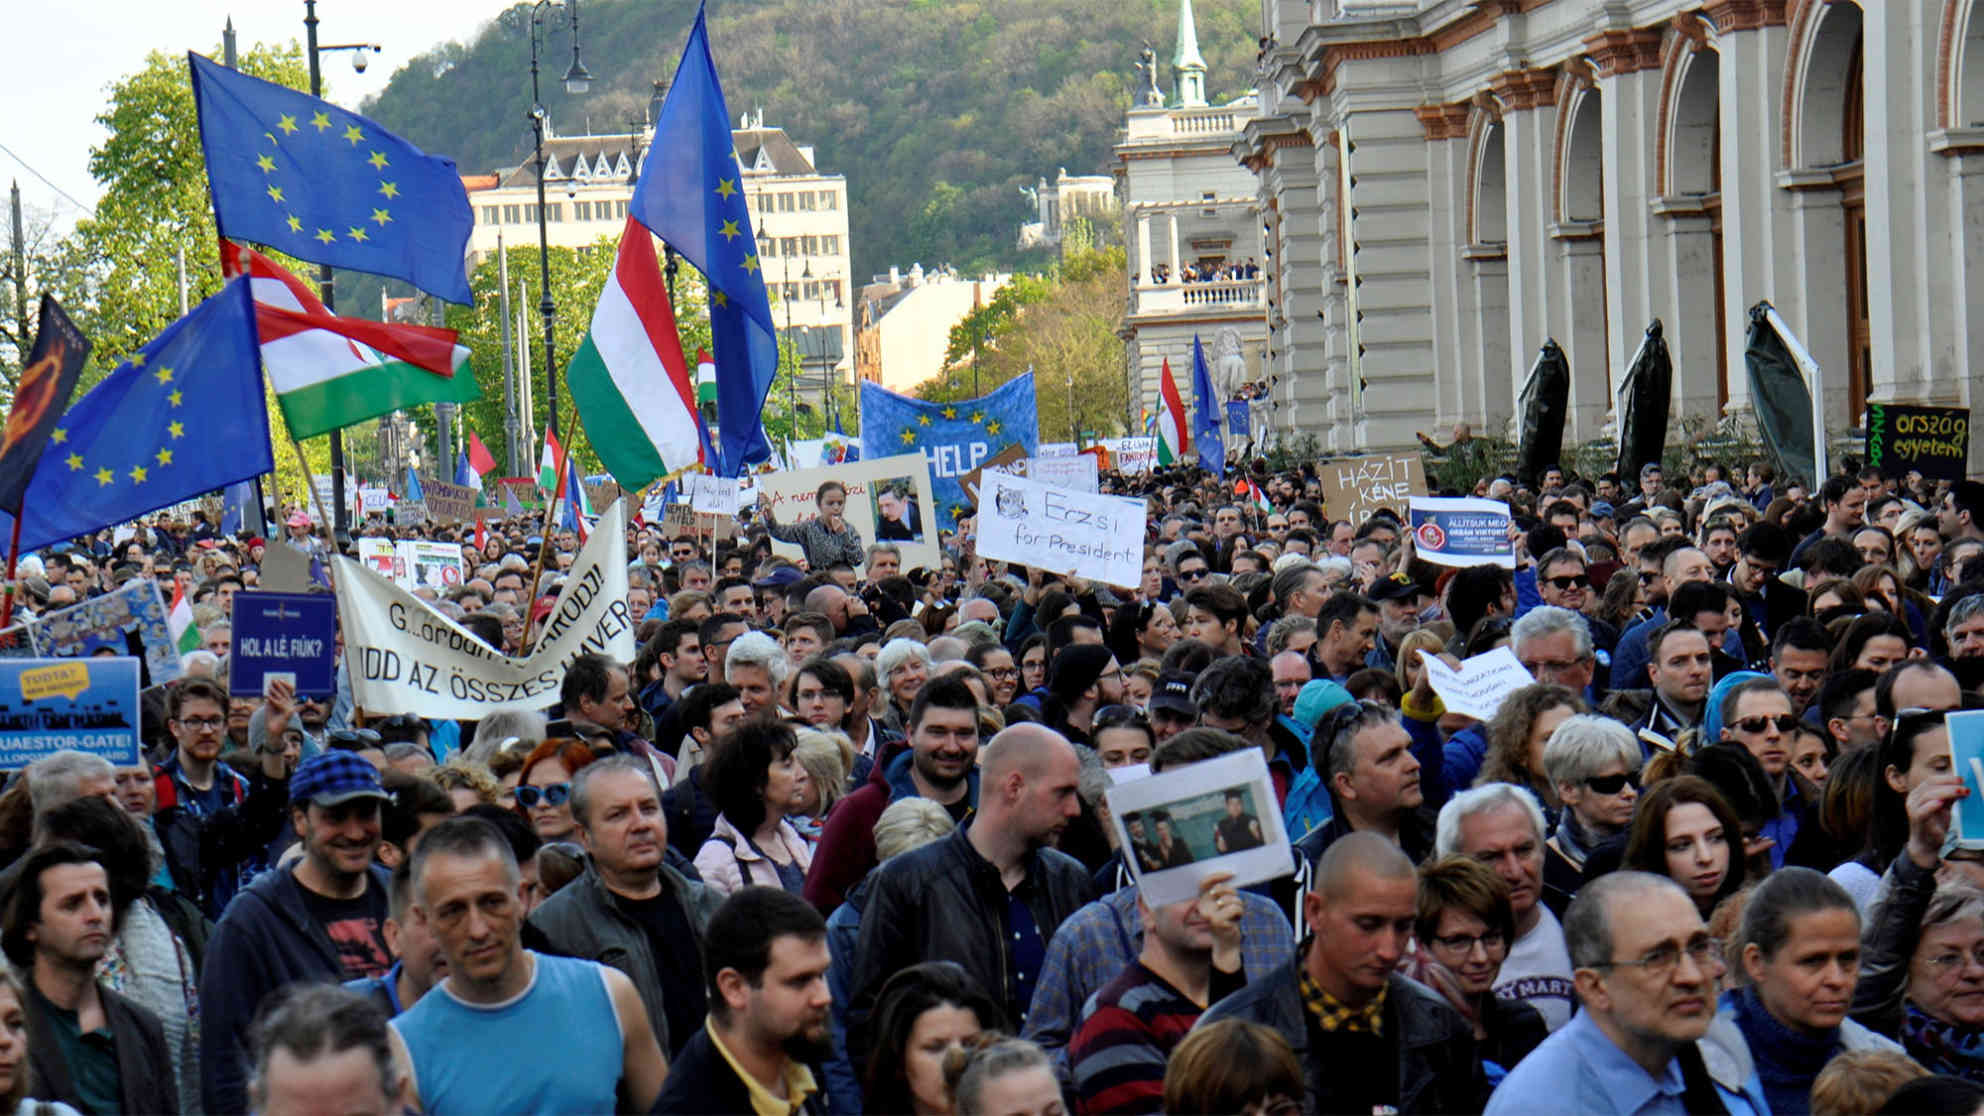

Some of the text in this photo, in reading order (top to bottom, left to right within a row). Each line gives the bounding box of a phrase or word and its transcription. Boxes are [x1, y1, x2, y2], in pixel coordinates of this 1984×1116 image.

[1895, 411, 1967, 447] ország
[920, 441, 988, 478] HELP
[1893, 438, 1963, 462] egyetem
[773, 491, 785, 505] A
[1359, 482, 1409, 504] KÉNE
[1045, 491, 1118, 533] Erzsi
[1015, 522, 1136, 562] for President
[240, 637, 262, 657] HOL
[263, 639, 272, 657] A
[291, 635, 322, 658] FIÚK?
[408, 660, 440, 694] AZ
[449, 665, 558, 703] ÖSSZES
